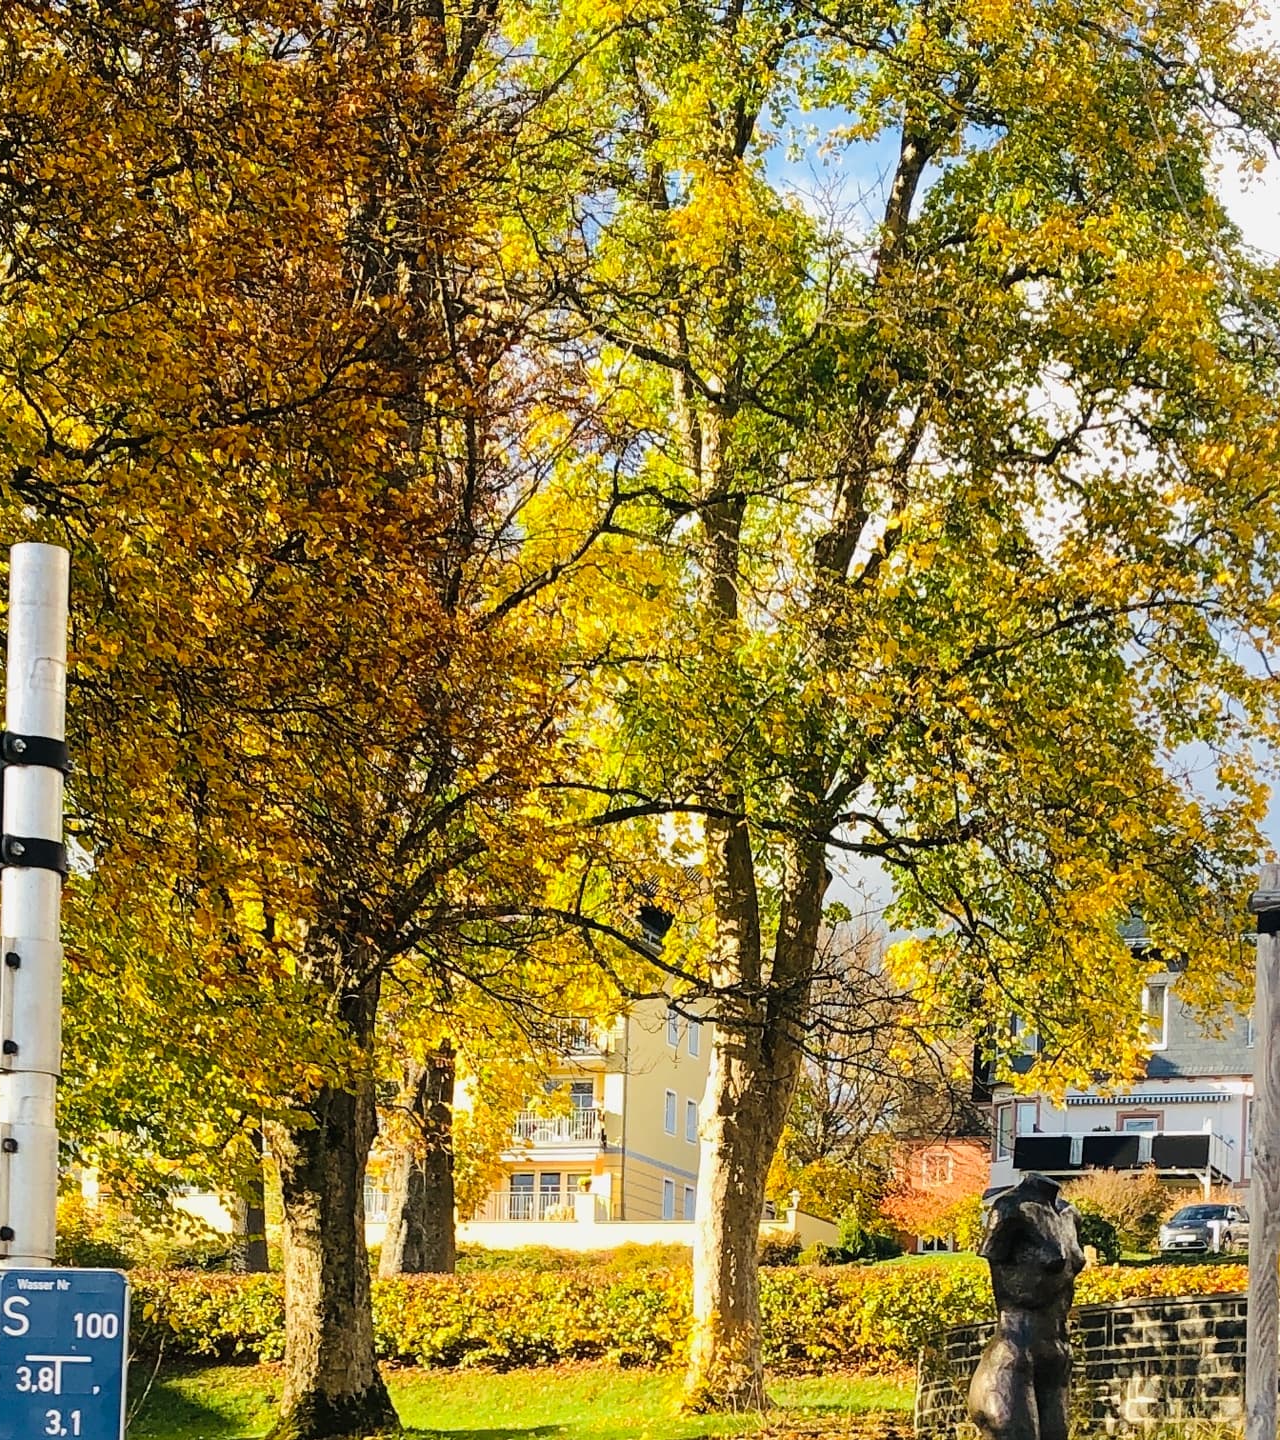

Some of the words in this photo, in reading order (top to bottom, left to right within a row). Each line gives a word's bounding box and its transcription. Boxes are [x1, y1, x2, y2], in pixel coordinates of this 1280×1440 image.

[17, 1278, 55, 1291] Wasser
[57, 1279, 71, 1291] Nr
[2, 1296, 31, 1337] S
[74, 1312, 119, 1339] 100
[16, 1366, 54, 1393] 3,8
[45, 1409, 82, 1437] 3,1
